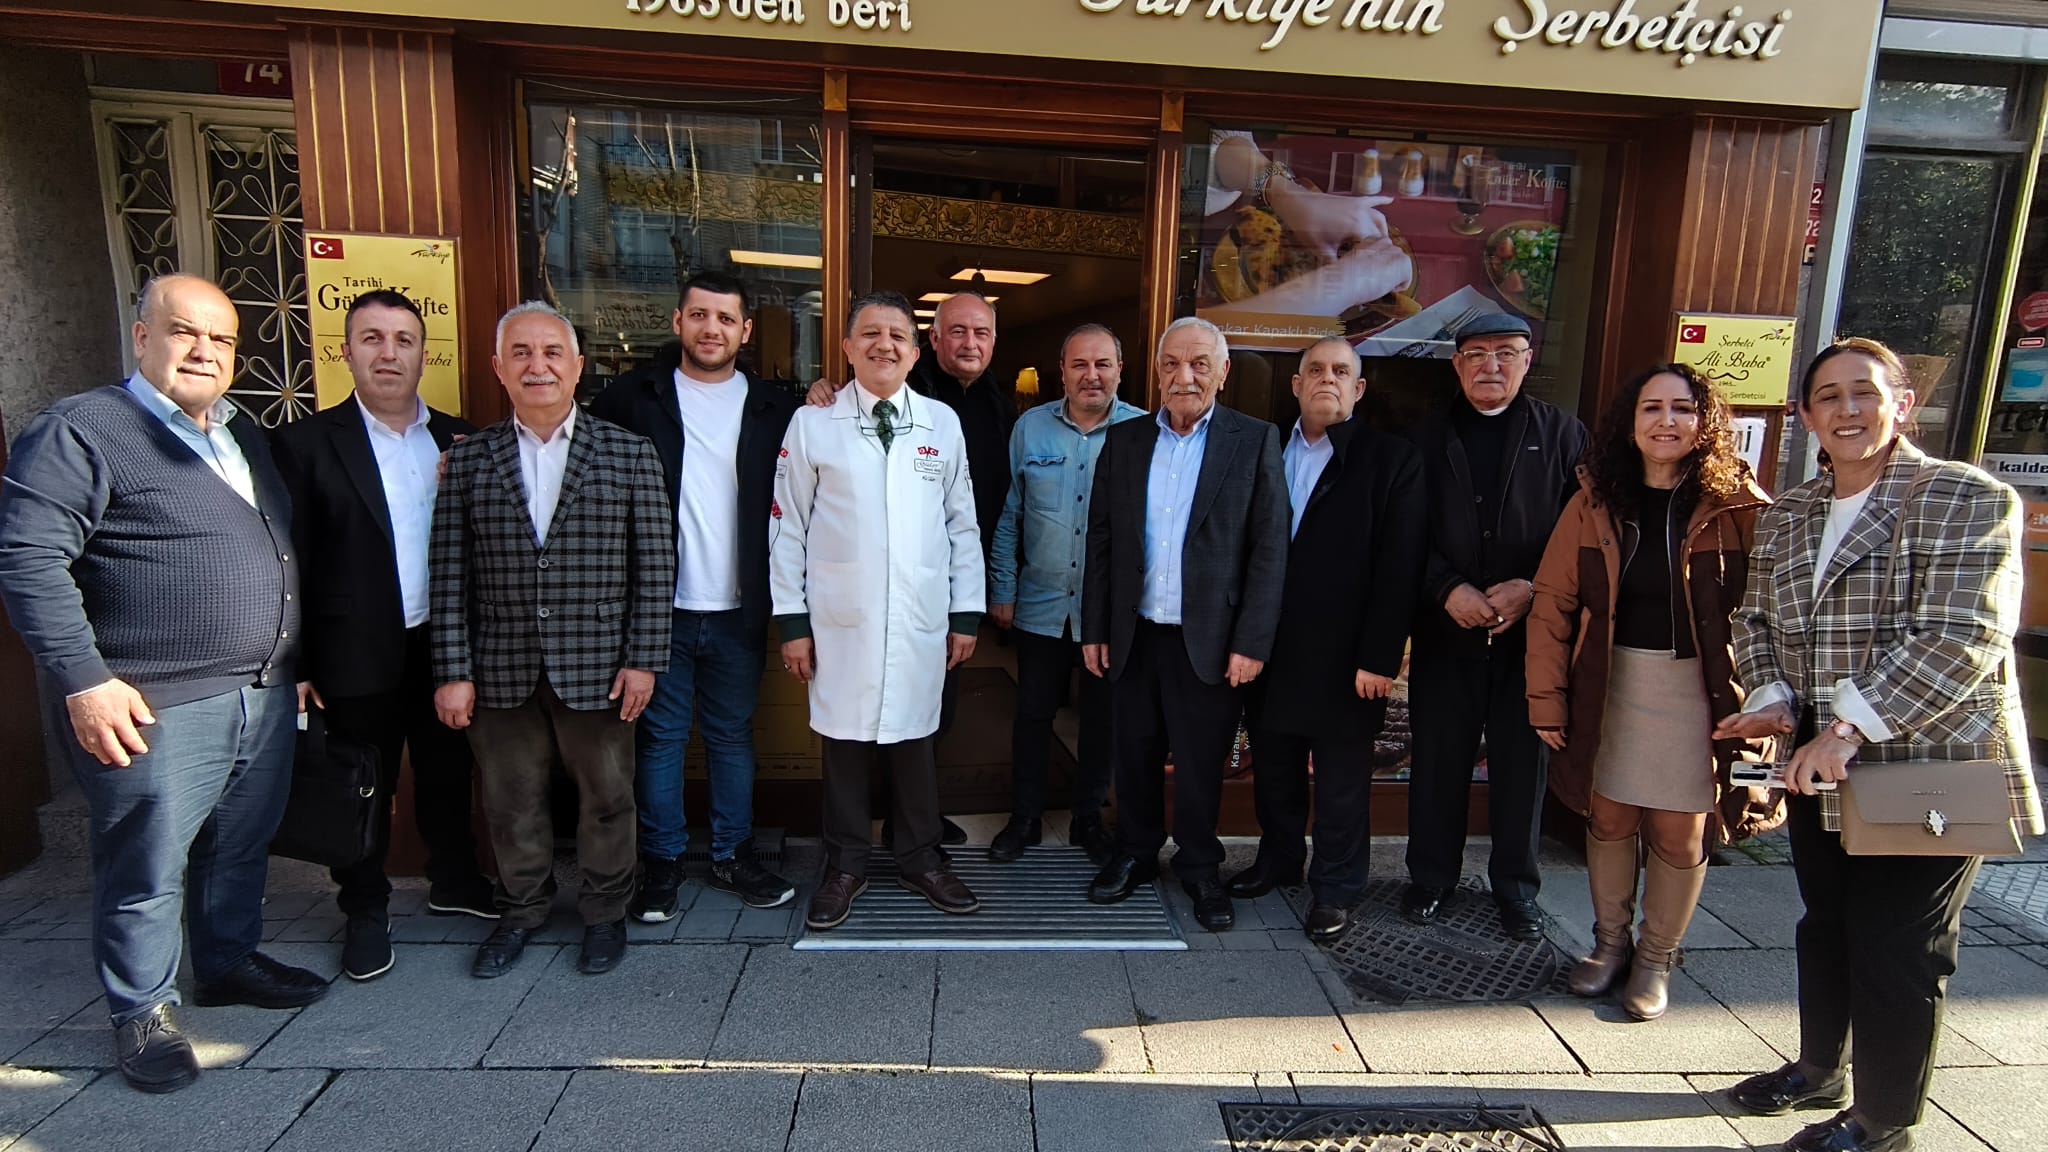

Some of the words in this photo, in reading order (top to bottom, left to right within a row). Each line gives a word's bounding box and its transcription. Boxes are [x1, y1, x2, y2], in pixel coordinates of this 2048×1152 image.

[828, 0, 912, 31] beri
[1493, 0, 1793, 65] Şerbetçisi
[343, 276, 383, 288] Tarihi
[1694, 350, 1722, 367] Ali
